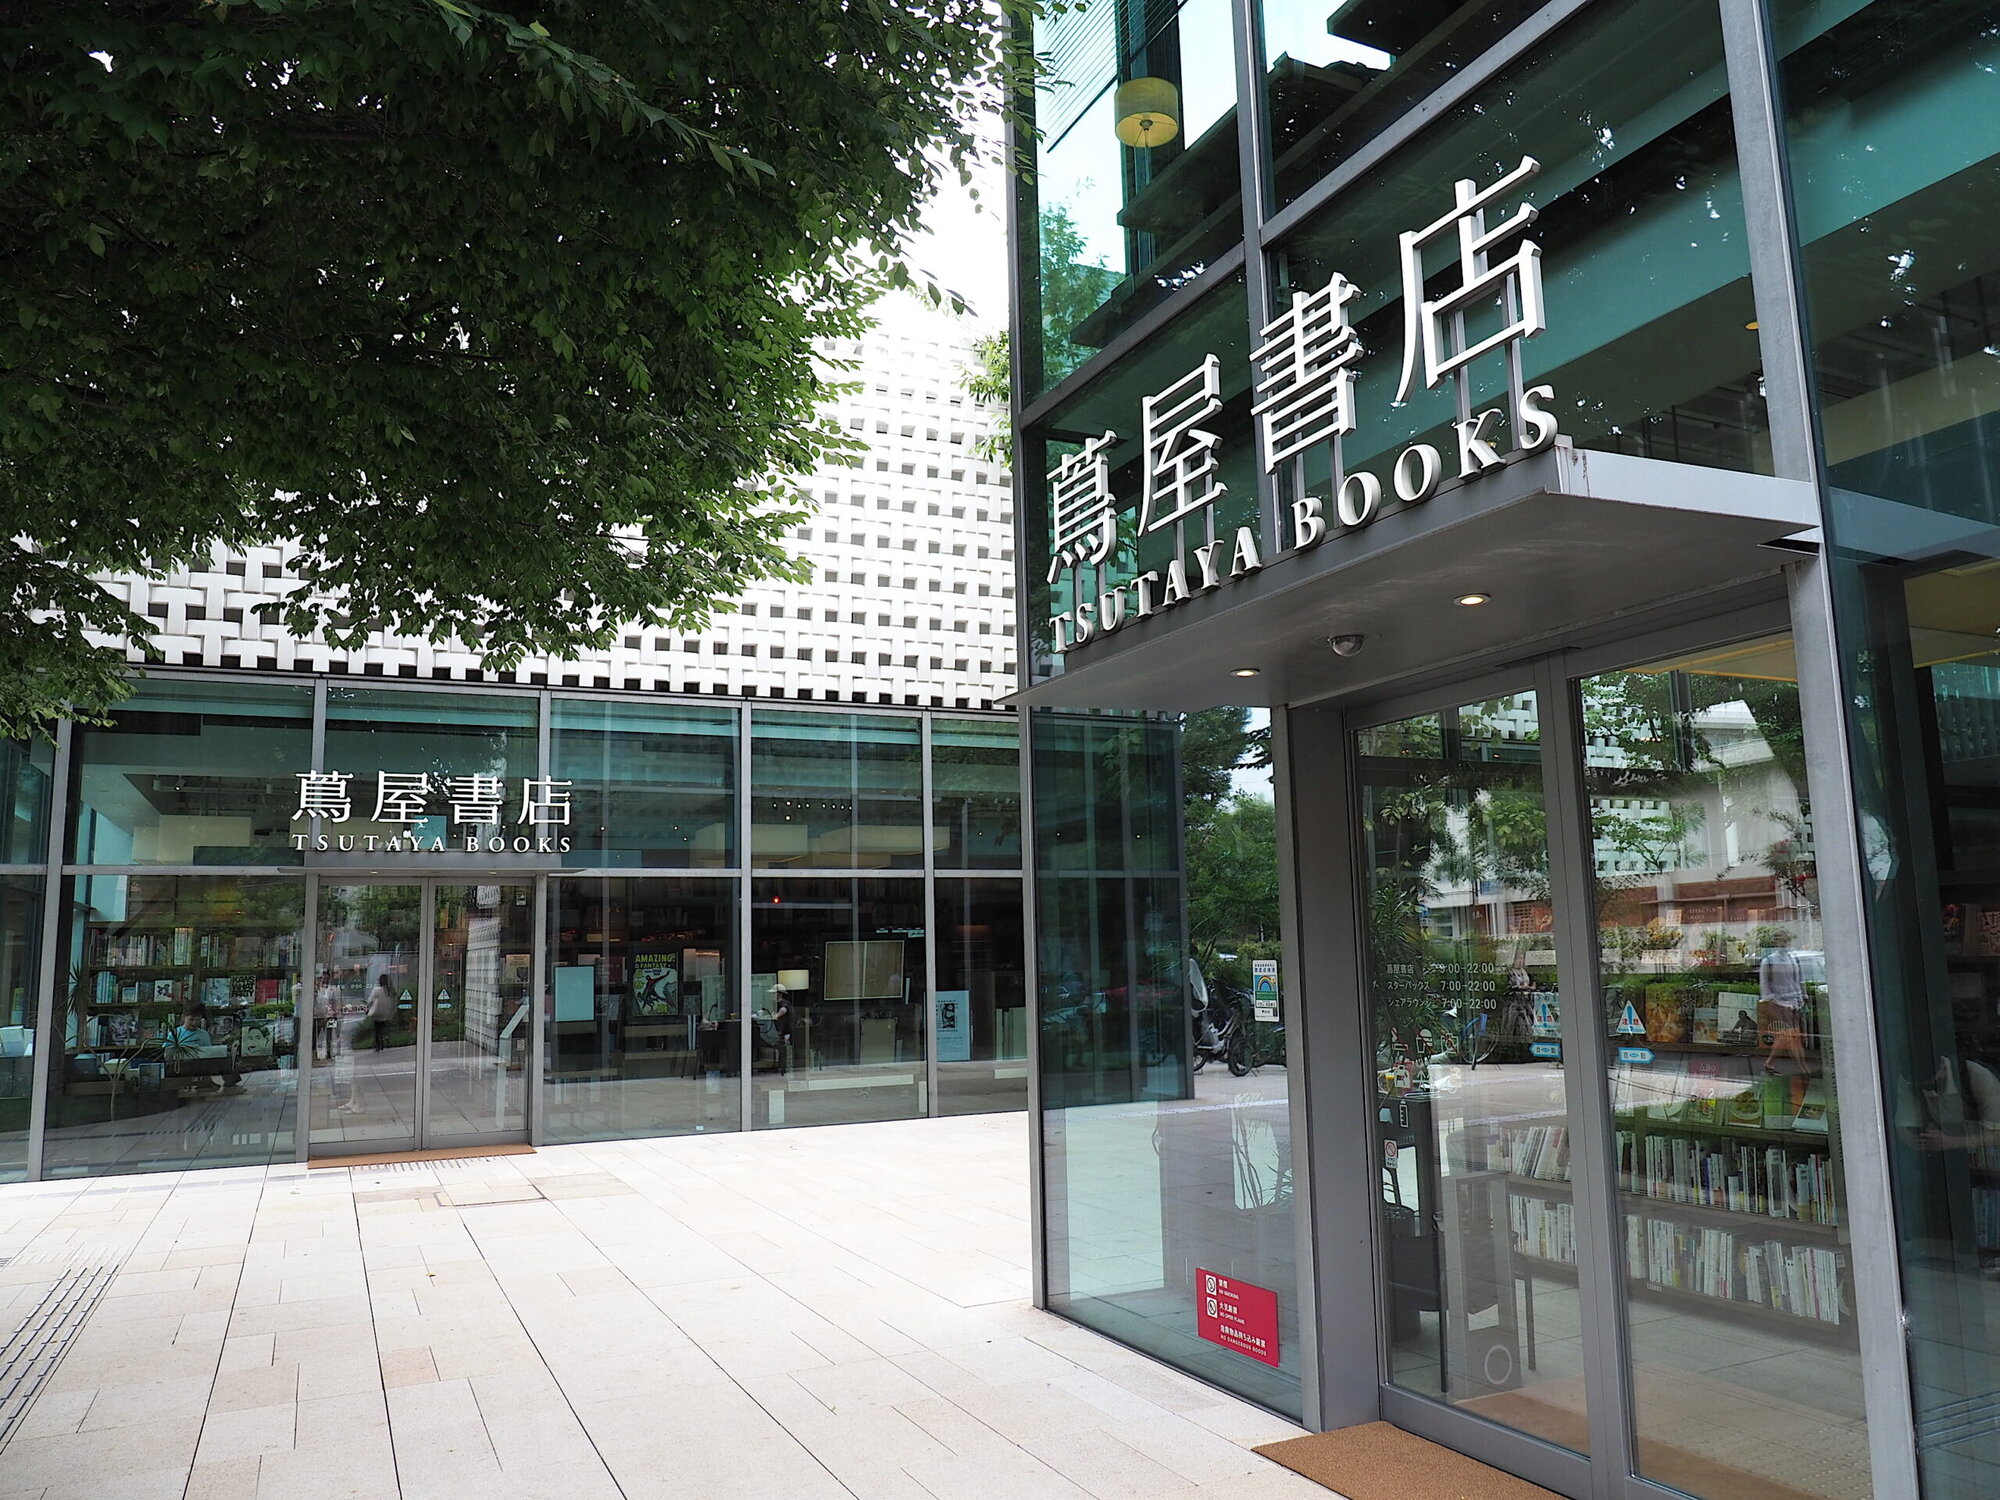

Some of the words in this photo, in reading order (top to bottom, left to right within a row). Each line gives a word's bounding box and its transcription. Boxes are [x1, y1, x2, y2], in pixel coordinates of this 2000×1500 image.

[1046, 155, 1546, 585] 蔦屋書店
[1048, 527, 1264, 654] TSUTAYA
[1292, 384, 1559, 551] BOOKS
[291, 769, 574, 825] 蔦屋書店
[292, 834, 446, 852] TSUTAYA
[466, 836, 572, 853] BOOKS
[1387, 980, 1431, 991] スターバックス
